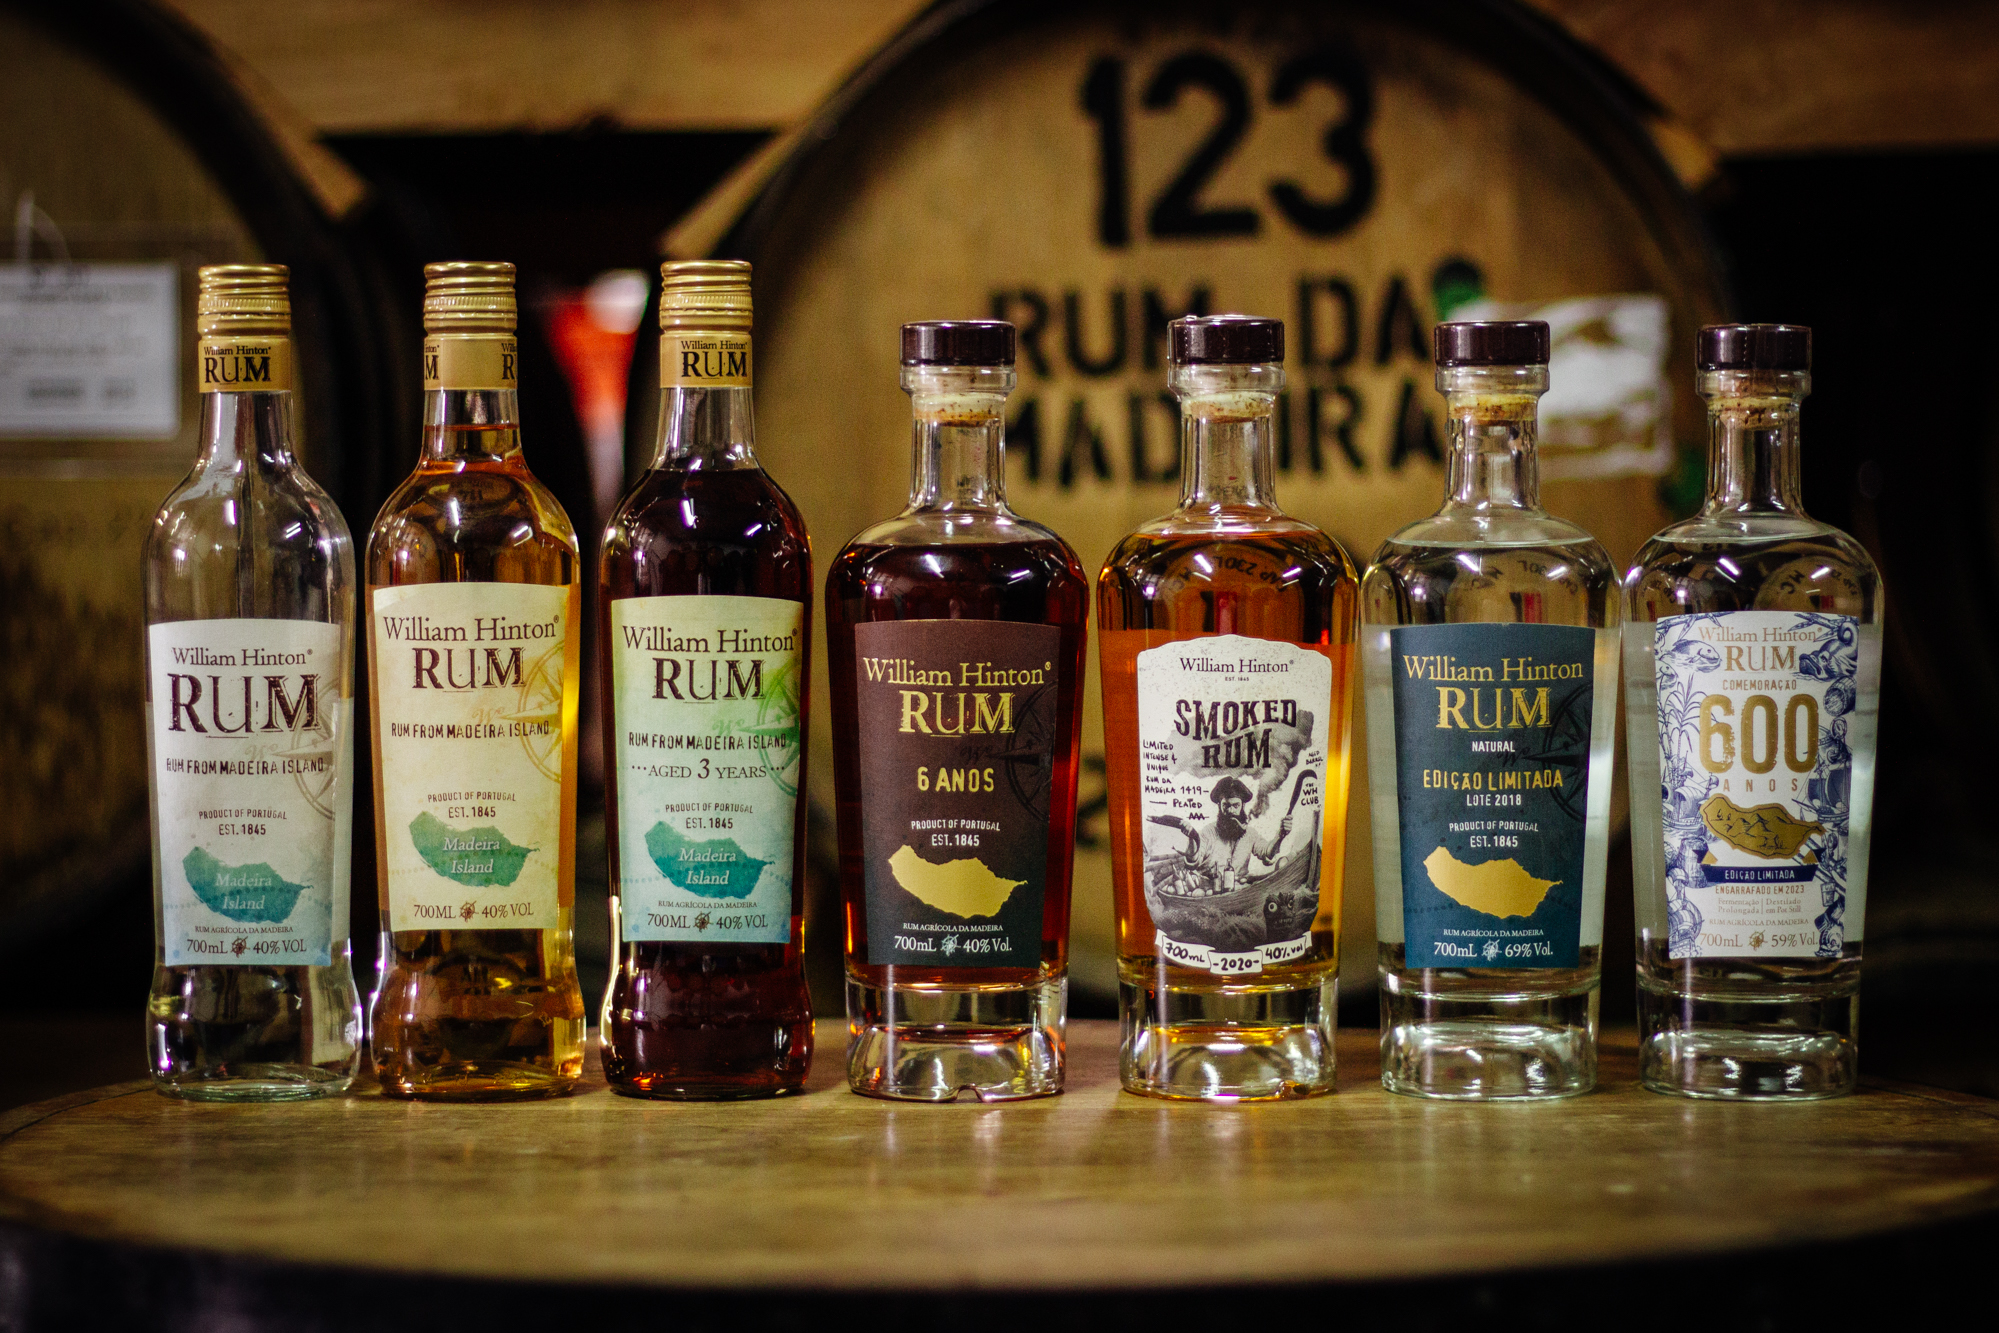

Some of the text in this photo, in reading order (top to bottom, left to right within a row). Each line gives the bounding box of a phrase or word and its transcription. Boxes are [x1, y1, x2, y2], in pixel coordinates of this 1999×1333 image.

[1079, 48, 1376, 250] 123
[1297, 277, 1430, 367] DA
[204, 356, 271, 383] RUM
[681, 351, 747, 377] RUM
[383, 617, 467, 641] William
[1698, 626, 1758, 641] William
[623, 625, 710, 652] William
[172, 648, 236, 666] William
[1724, 646, 1796, 671] RUM
[412, 647, 525, 689] RUM
[864, 658, 952, 685] William
[1180, 658, 1234, 672] William
[1403, 655, 1583, 681] William Hinton
[652, 657, 766, 700] RUM
[1723, 679, 1796, 690] COMEMORAÇÃO
[167, 673, 321, 733] RUM
[1436, 686, 1551, 729] RUM
[899, 690, 1015, 734] RUM
[1174, 699, 1296, 740] SMOKED
[391, 721, 549, 739] RUM FROM MADEIRA ISLAND
[1700, 693, 1819, 774] 600
[629, 732, 786, 750] RUM FROM MADEIRA ISLAND
[1202, 728, 1272, 768] RUM
[1472, 741, 1515, 752] NATURAL
[166, 757, 324, 775] RUM FROM MADEIRA ISLAND
[698, 758, 710, 779] 3
[918, 768, 994, 792] 6 ANOS
[1424, 770, 1563, 791] EDIÇÃO LIMITADA
[428, 792, 516, 803] PRODUCT OF PORTUGAL
[1303, 787, 1317, 796] WH
[665, 802, 753, 813] PRODUCT OF PORTUGAL
[1301, 796, 1319, 806] CLUB
[1467, 794, 1521, 806] LOTE 2018
[199, 809, 287, 820] PRODUCT OF PORTUGAL
[471, 806, 496, 818] 1845
[241, 824, 266, 835] 1845
[709, 818, 733, 829] 1845
[911, 820, 1000, 831] PRODUCT OF PORTUGAL
[1449, 821, 1538, 832] PRODUCT OF PORTUGAL
[444, 838, 500, 851] Madeira
[932, 835, 979, 846] EST. 1845
[1470, 836, 1518, 847] EST. 1845
[679, 849, 736, 862] Madeira
[451, 860, 493, 873] Island
[215, 874, 272, 887] Madeira
[686, 871, 729, 884] Island
[1725, 870, 1795, 880] EDIÇÃO LIMITADA
[1716, 885, 1804, 894] ENGARRAFADO EM 2023
[223, 896, 265, 910] Island
[414, 903, 534, 919] 700ML 40% VOL
[647, 913, 768, 929] 700ML 40% VOL
[920, 923, 957, 931] AGRÍCOLA
[1460, 929, 1498, 937] AGRÍCOLA
[1700, 932, 1818, 947] 700mL 59% Vol.
[187, 939, 306, 955] 700mL 40% VOL
[895, 936, 1012, 953] 700mL 40% Vol.
[1434, 942, 1553, 957] 700mL 69% Vol.
